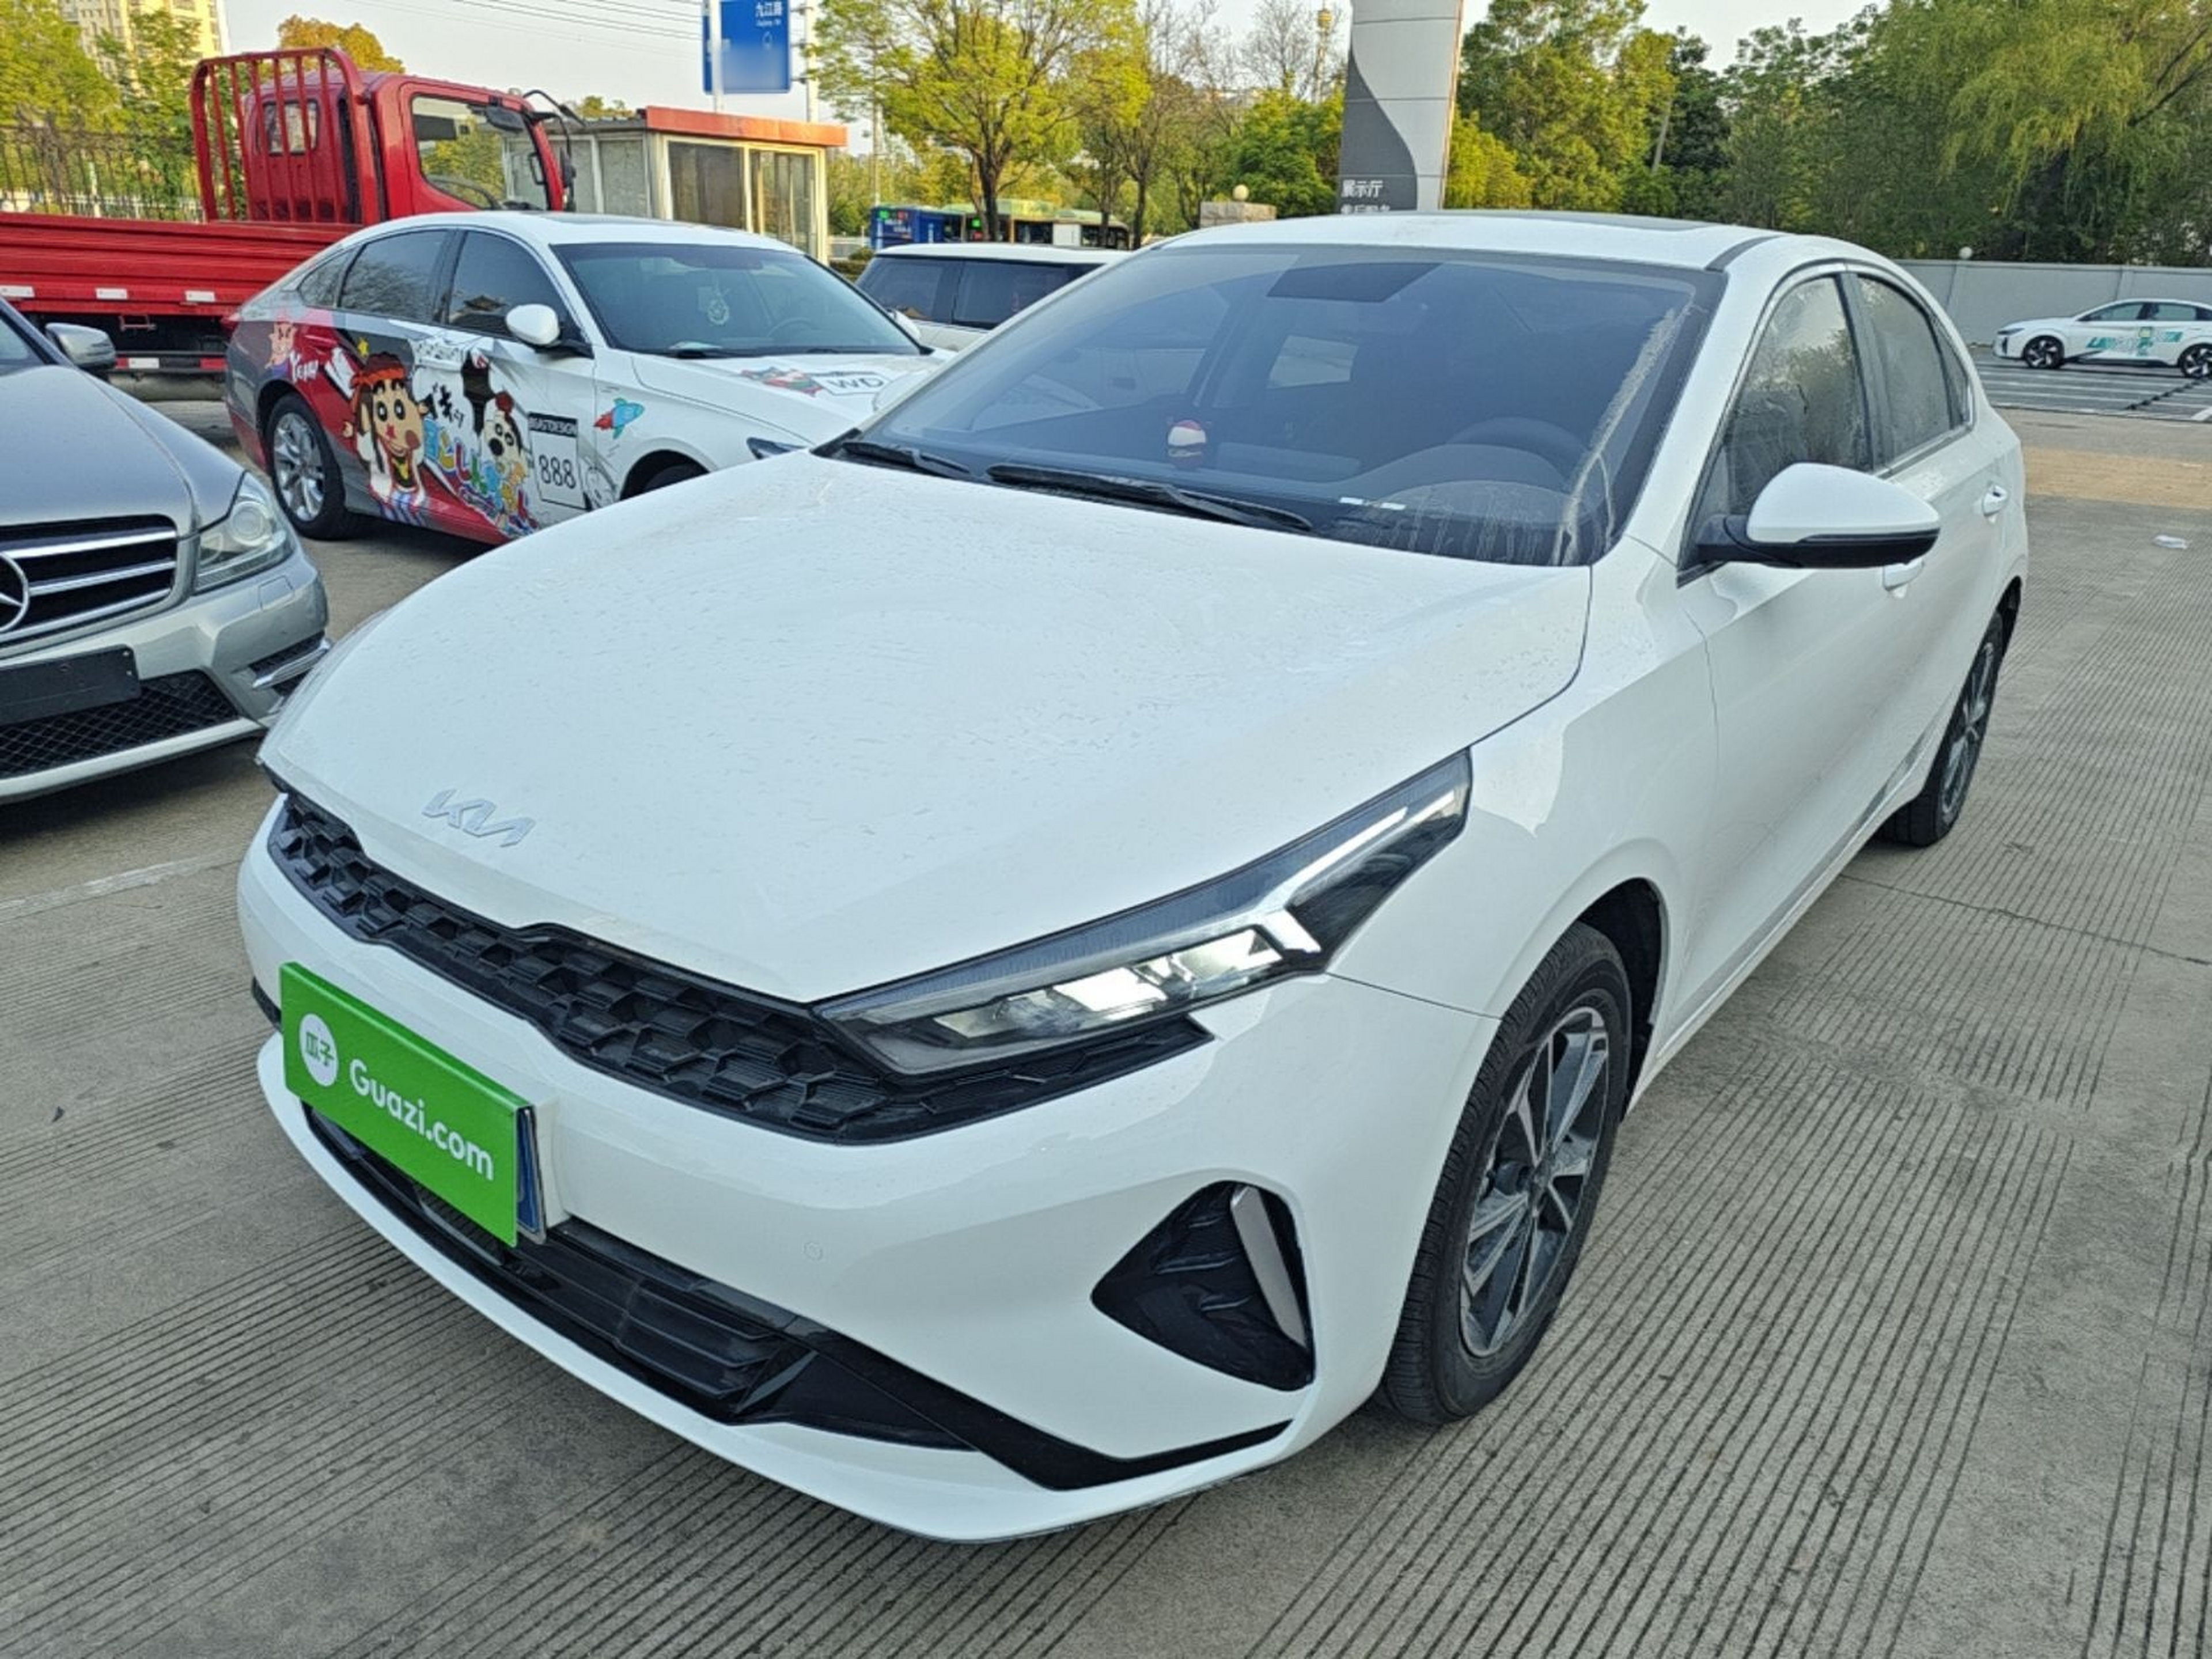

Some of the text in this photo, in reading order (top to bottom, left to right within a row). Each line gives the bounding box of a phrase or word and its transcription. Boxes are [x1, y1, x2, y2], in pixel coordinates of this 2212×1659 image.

[1342, 179, 1383, 198] 展示厅
[539, 454, 576, 489] 888
[305, 1031, 335, 1067] 瓜子
[350, 1059, 494, 1181] Guazi.com
